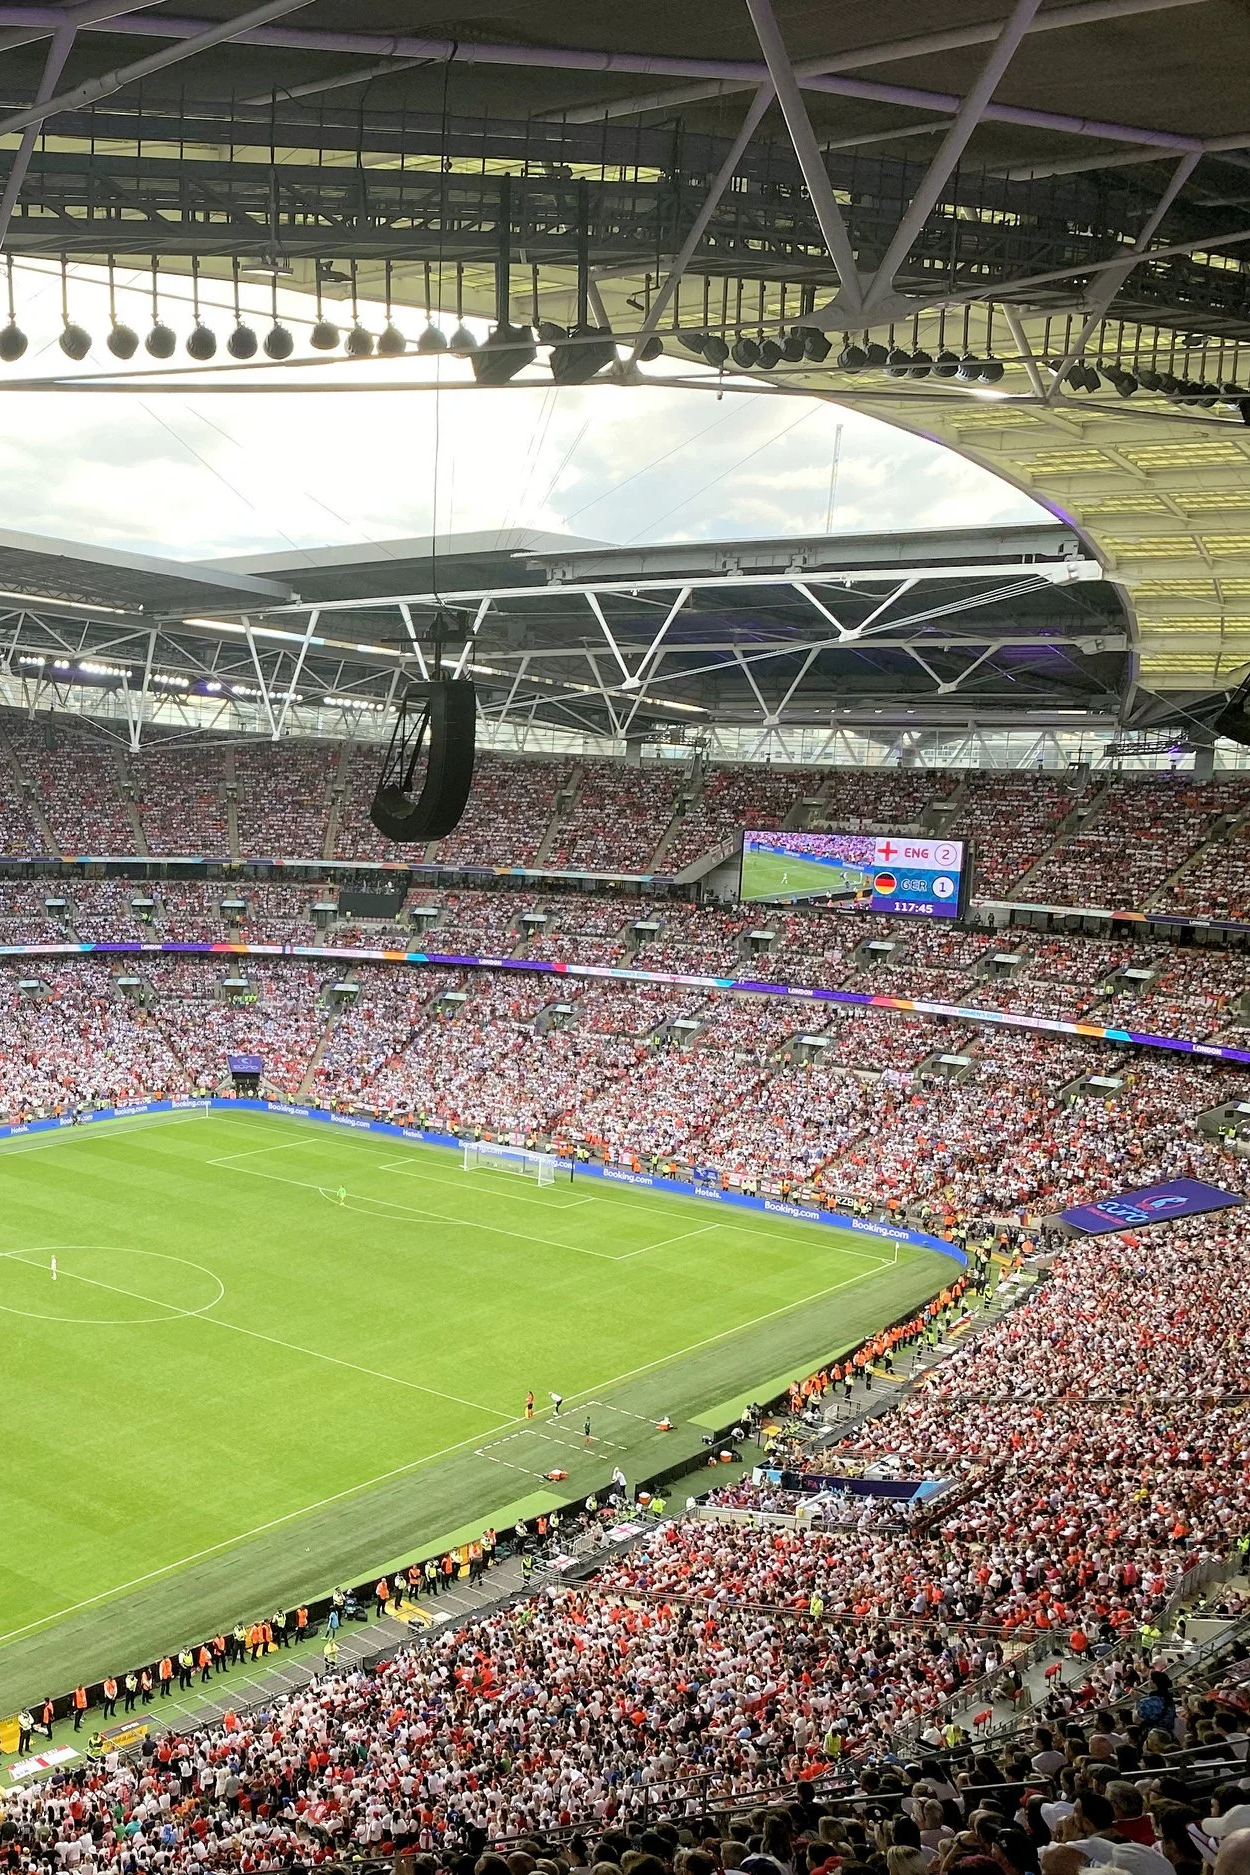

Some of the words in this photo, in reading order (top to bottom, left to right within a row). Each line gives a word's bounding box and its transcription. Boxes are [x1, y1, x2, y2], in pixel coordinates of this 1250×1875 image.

[904, 847, 929, 859] ENG
[942, 848, 950, 859] 2
[901, 879, 927, 892] GER
[939, 882, 946, 892] 1
[894, 901, 934, 914] 117:45
[787, 987, 813, 996] LONDON
[1192, 1045, 1222, 1056] LONDON
[268, 1102, 309, 1117] Booking.com
[330, 1113, 370, 1129] Booking.com
[603, 1168, 653, 1185] Booking.com
[694, 1187, 722, 1199] Hotels.
[764, 1200, 820, 1220] Booking.com
[852, 1218, 909, 1240] Booking.com
